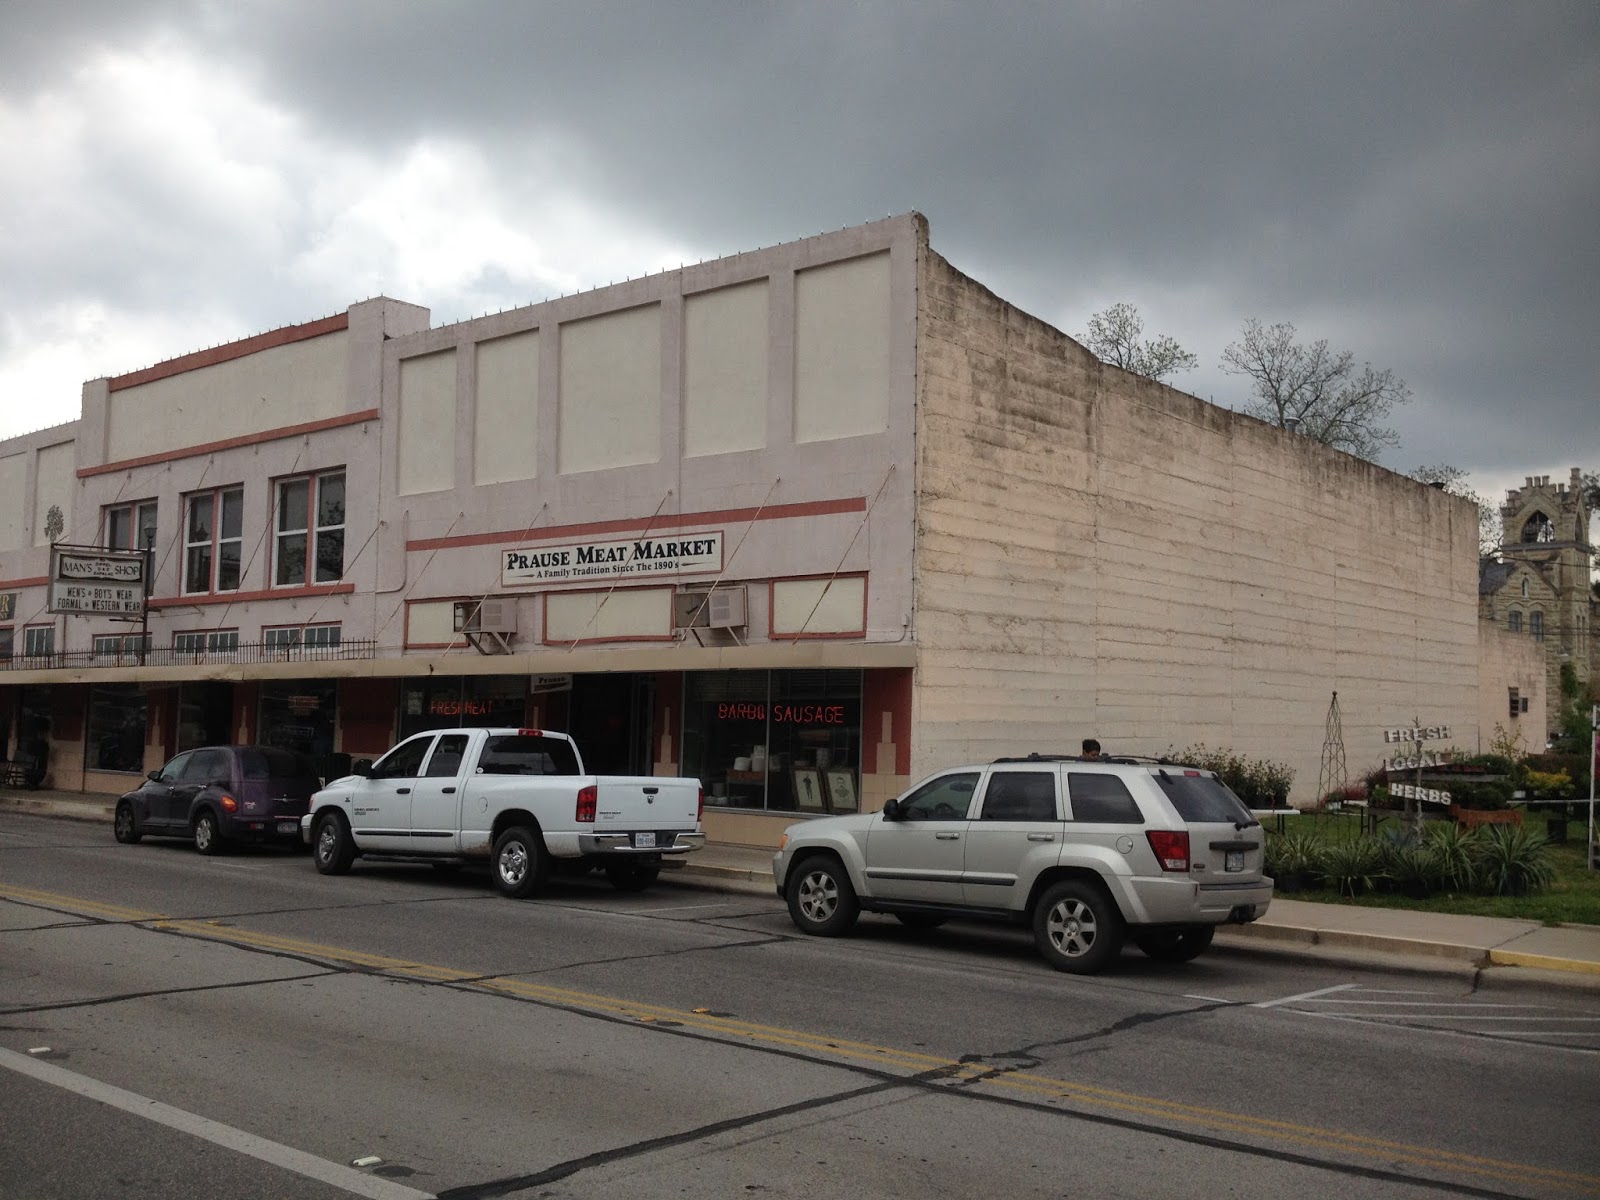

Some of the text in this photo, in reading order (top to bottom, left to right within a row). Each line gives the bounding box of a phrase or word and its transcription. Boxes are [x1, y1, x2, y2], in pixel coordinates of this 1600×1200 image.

[507, 539, 716, 570] PRAUSE MEAT MARKET
[63, 562, 92, 573] MAN'S
[115, 565, 139, 576] SHOP
[544, 568, 571, 578] Family
[572, 564, 611, 576] Tradition
[612, 564, 635, 573] Since
[636, 562, 652, 571] The
[654, 560, 679, 570] 1890's
[67, 587, 86, 598] MEN'S
[94, 588, 113, 599] BOY'S
[117, 590, 133, 600] WEAR
[57, 598, 82, 609] FORMAL
[92, 600, 121, 611] WESTERN
[125, 601, 141, 612] WEAR
[774, 705, 844, 724] SAUSAGE
[1384, 725, 1451, 743] FRESH
[1384, 753, 1447, 772] LOCAL
[1389, 782, 1452, 806] HERBS
